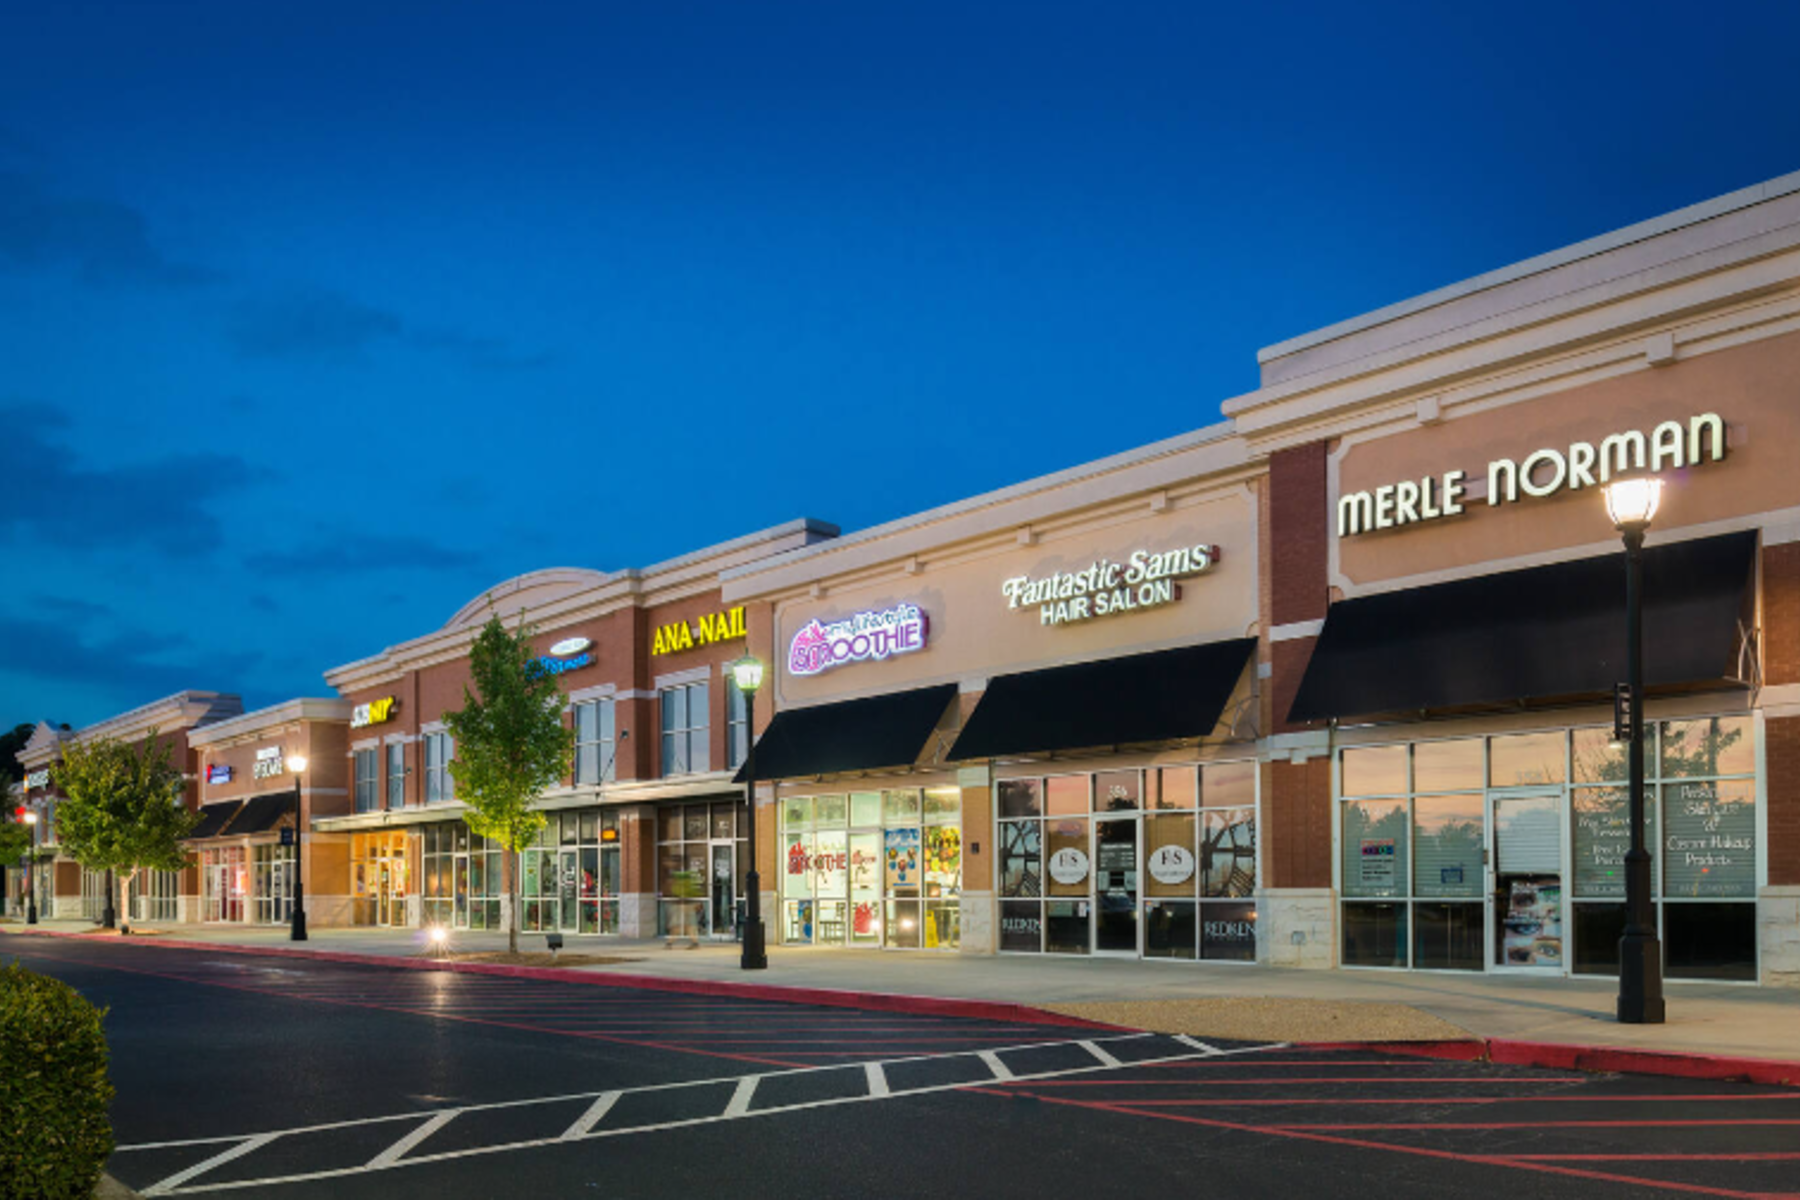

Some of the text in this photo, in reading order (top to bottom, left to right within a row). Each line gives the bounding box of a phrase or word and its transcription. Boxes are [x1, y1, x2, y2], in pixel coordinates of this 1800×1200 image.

[1338, 412, 1724, 536] MERLE NORMAN
[1002, 544, 1212, 609] Fantastic Sams
[1041, 579, 1172, 625] HAIR SALON
[652, 606, 747, 655] ANA NAIL
[794, 622, 918, 668] SMOOTHIE
